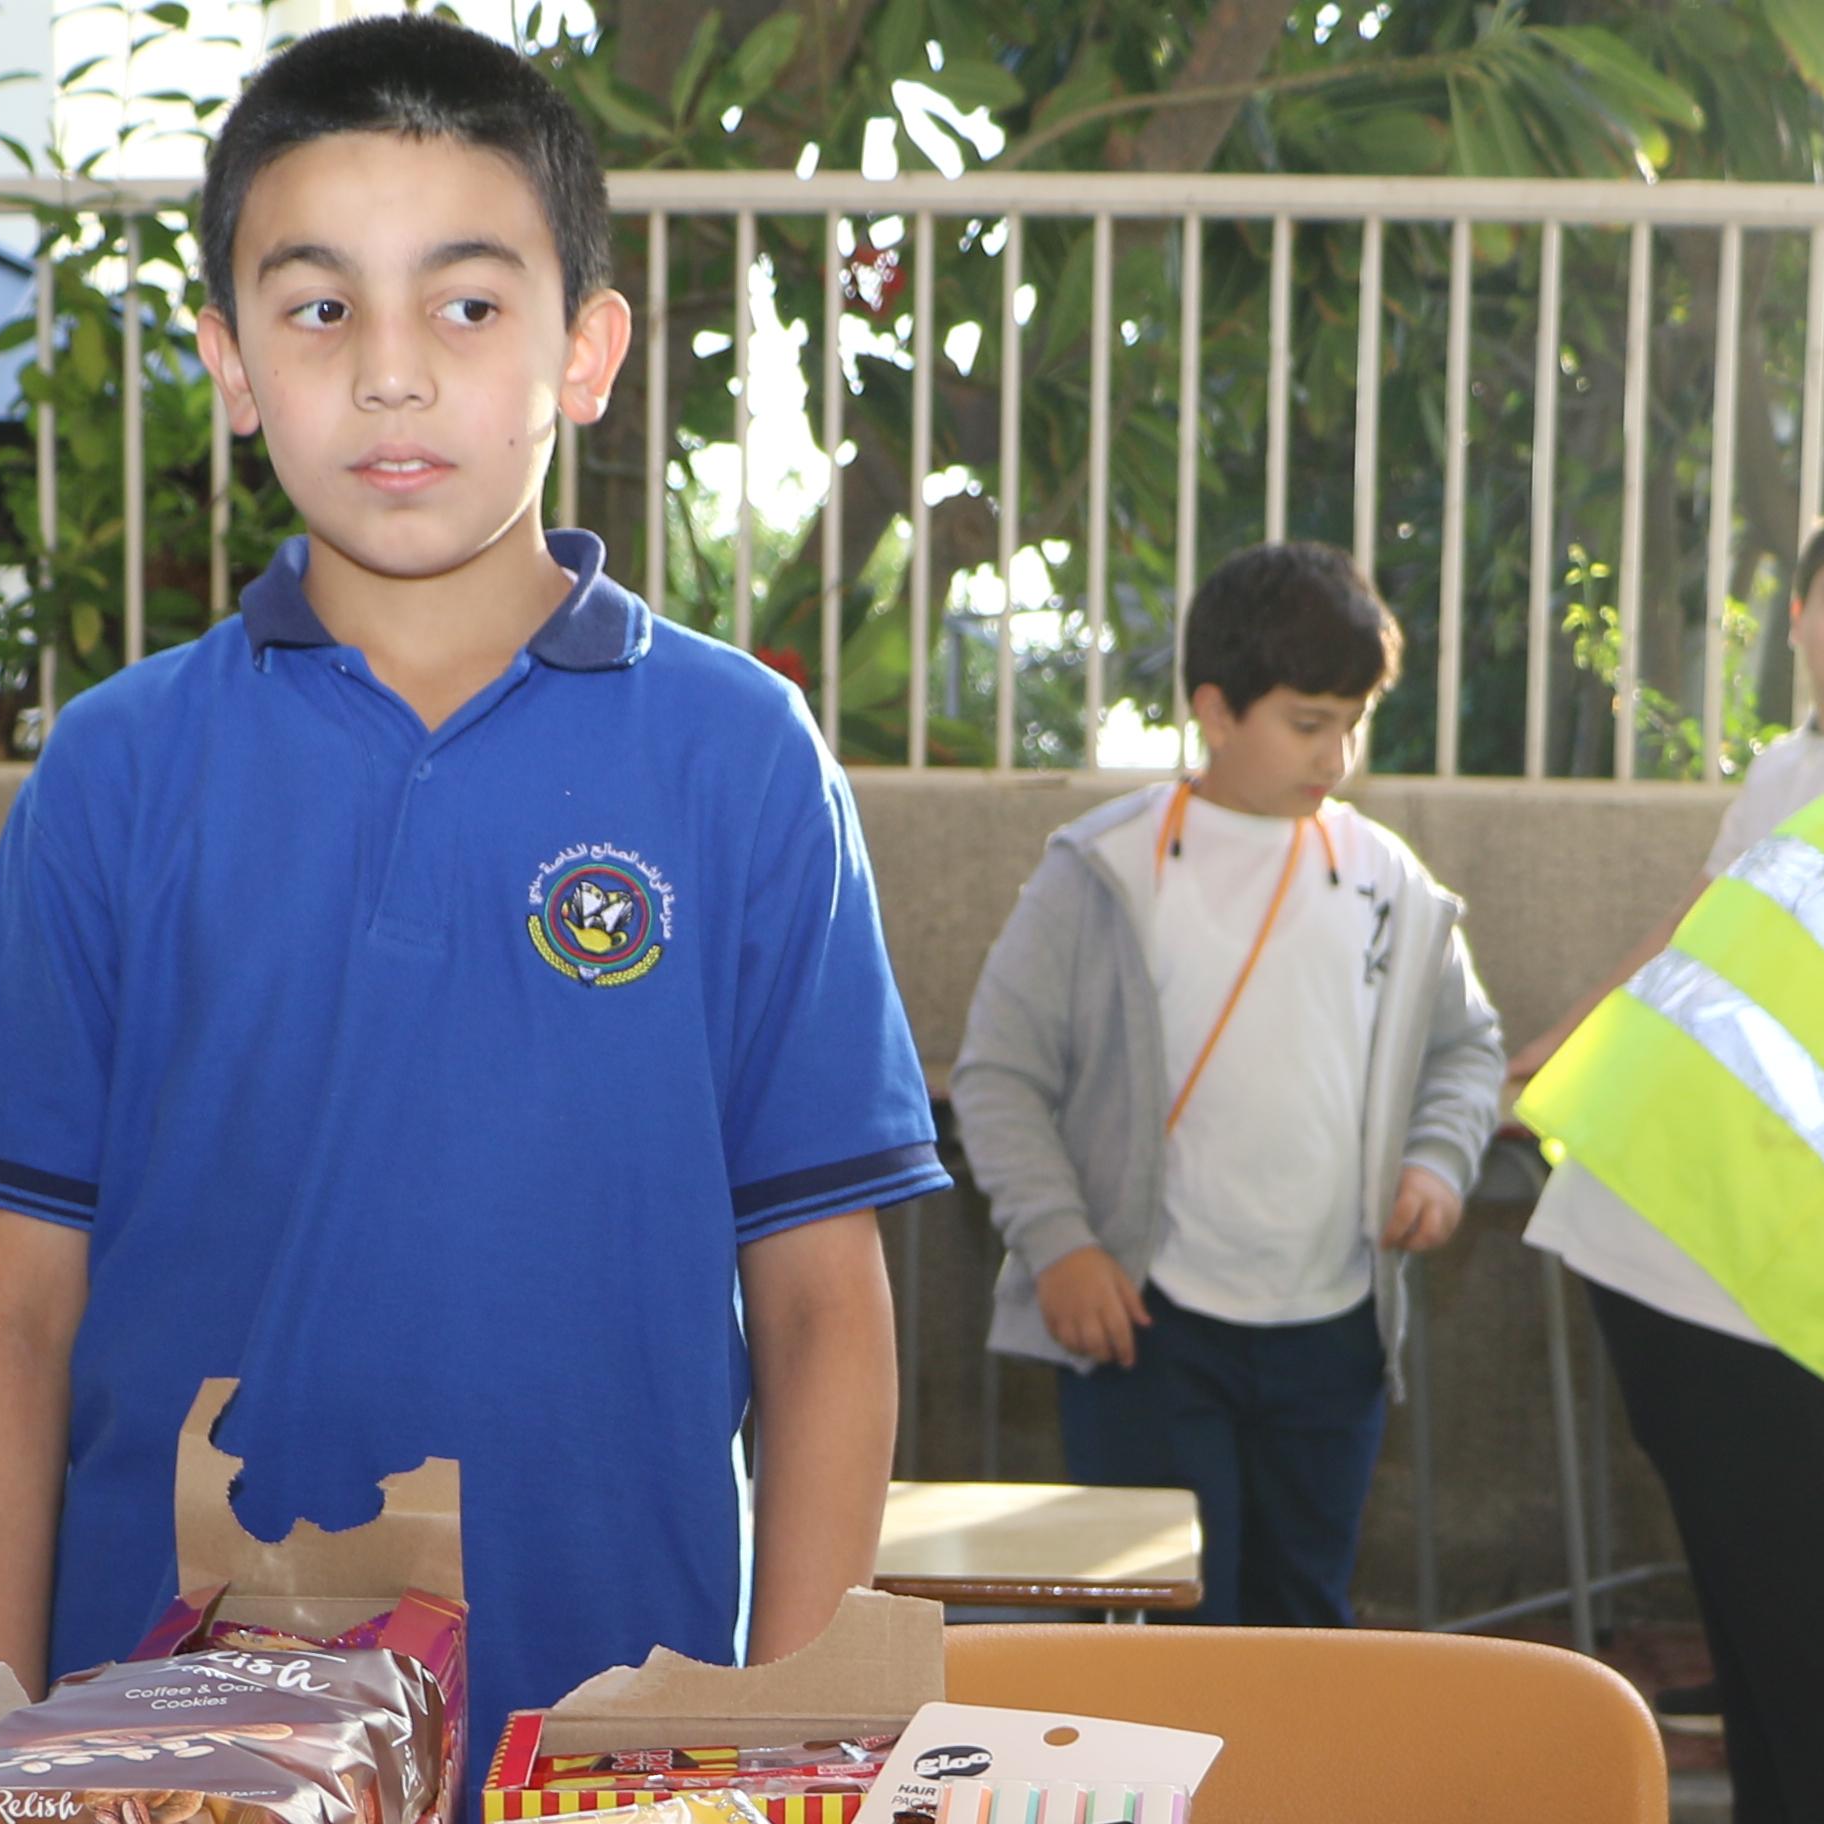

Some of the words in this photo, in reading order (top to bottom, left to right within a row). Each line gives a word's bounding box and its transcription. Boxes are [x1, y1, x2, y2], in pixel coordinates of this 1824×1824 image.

[124, 1684, 193, 1700] Coffee
[196, 1684, 213, 1695] &
[217, 1682, 265, 1694] Oats
[150, 1696, 229, 1711] Cookies
[897, 1783, 938, 1797] HAIR
